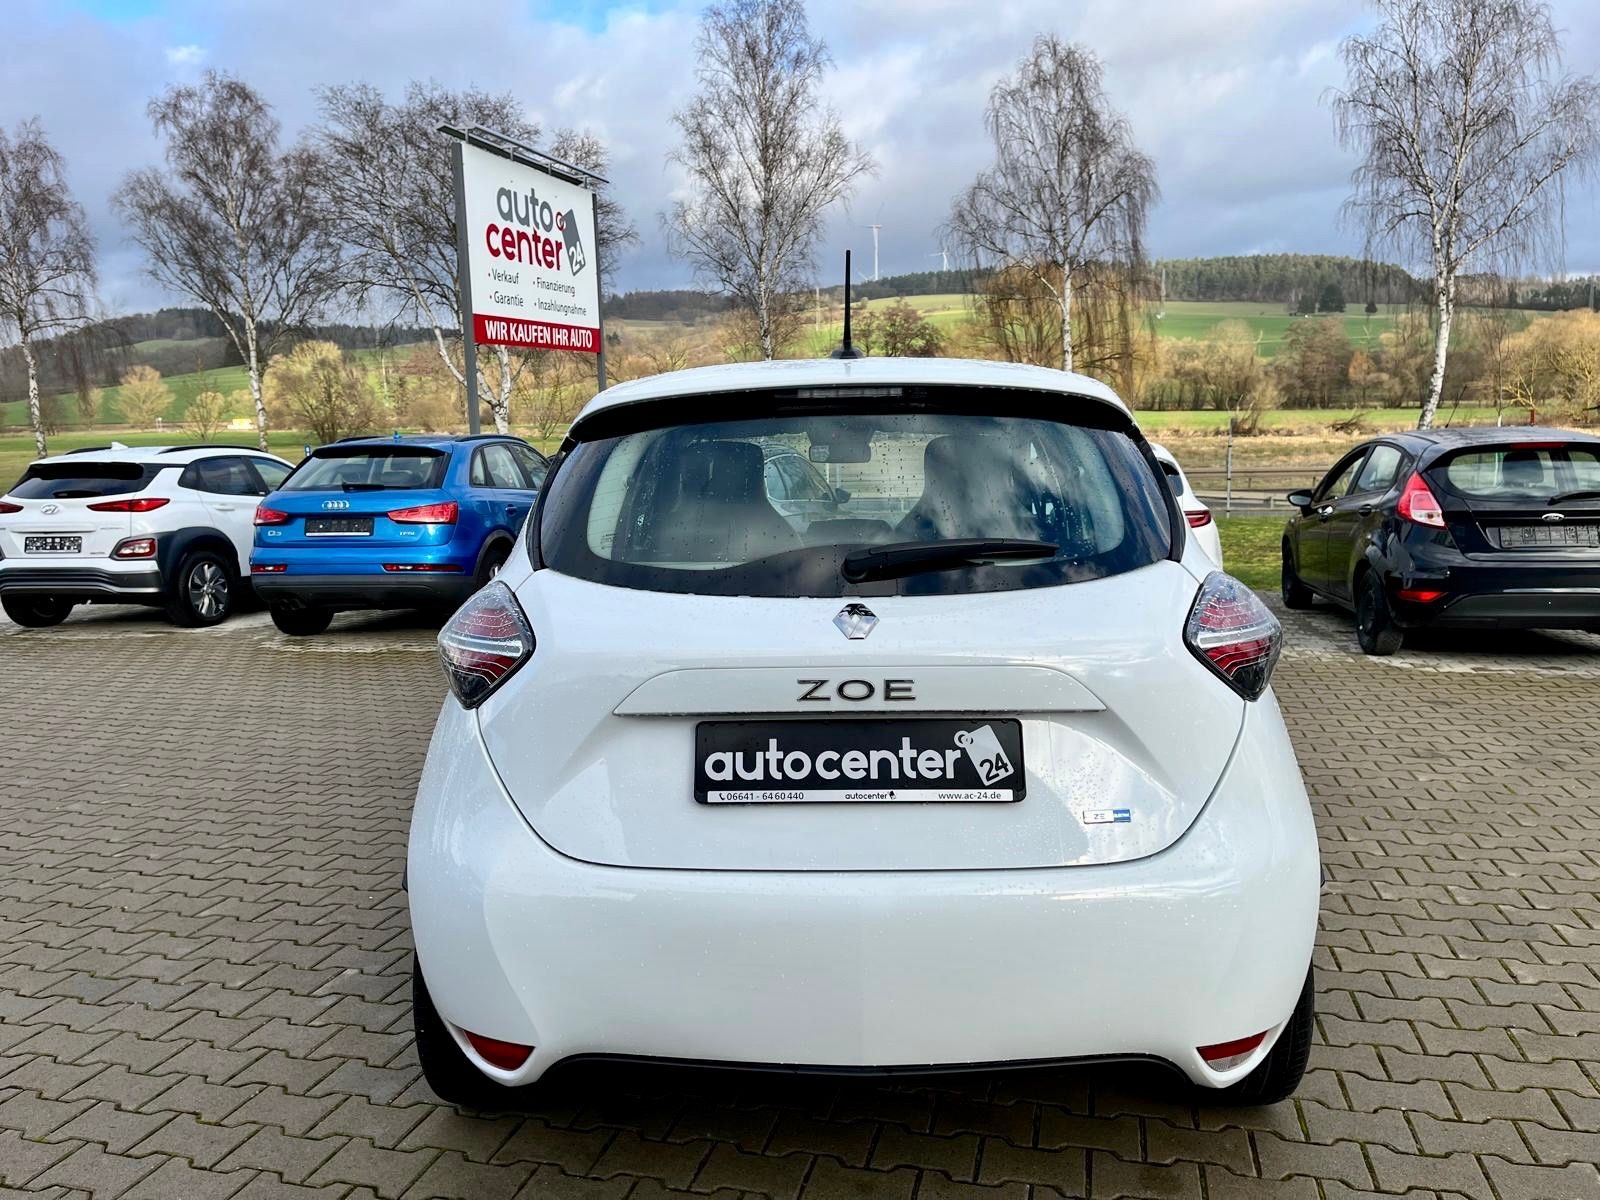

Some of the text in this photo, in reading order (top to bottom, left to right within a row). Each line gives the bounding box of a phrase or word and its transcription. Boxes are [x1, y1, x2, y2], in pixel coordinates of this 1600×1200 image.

[497, 186, 553, 233] auto
[486, 223, 563, 271] center
[569, 241, 585, 270] 24
[492, 268, 519, 284] Verkauf
[537, 277, 576, 297] Finanzierung
[494, 291, 524, 307] Garantie
[538, 298, 587, 316] Inzahlungnahme
[485, 320, 593, 348] WIR KAUFEN IHR AUTO
[797, 679, 916, 702] ZOE
[704, 737, 961, 781] autocenter
[979, 753, 1009, 782] 24
[726, 792, 754, 800] 06641
[844, 792, 888, 800] autocenter
[938, 792, 1002, 800] www.ac-24.de
